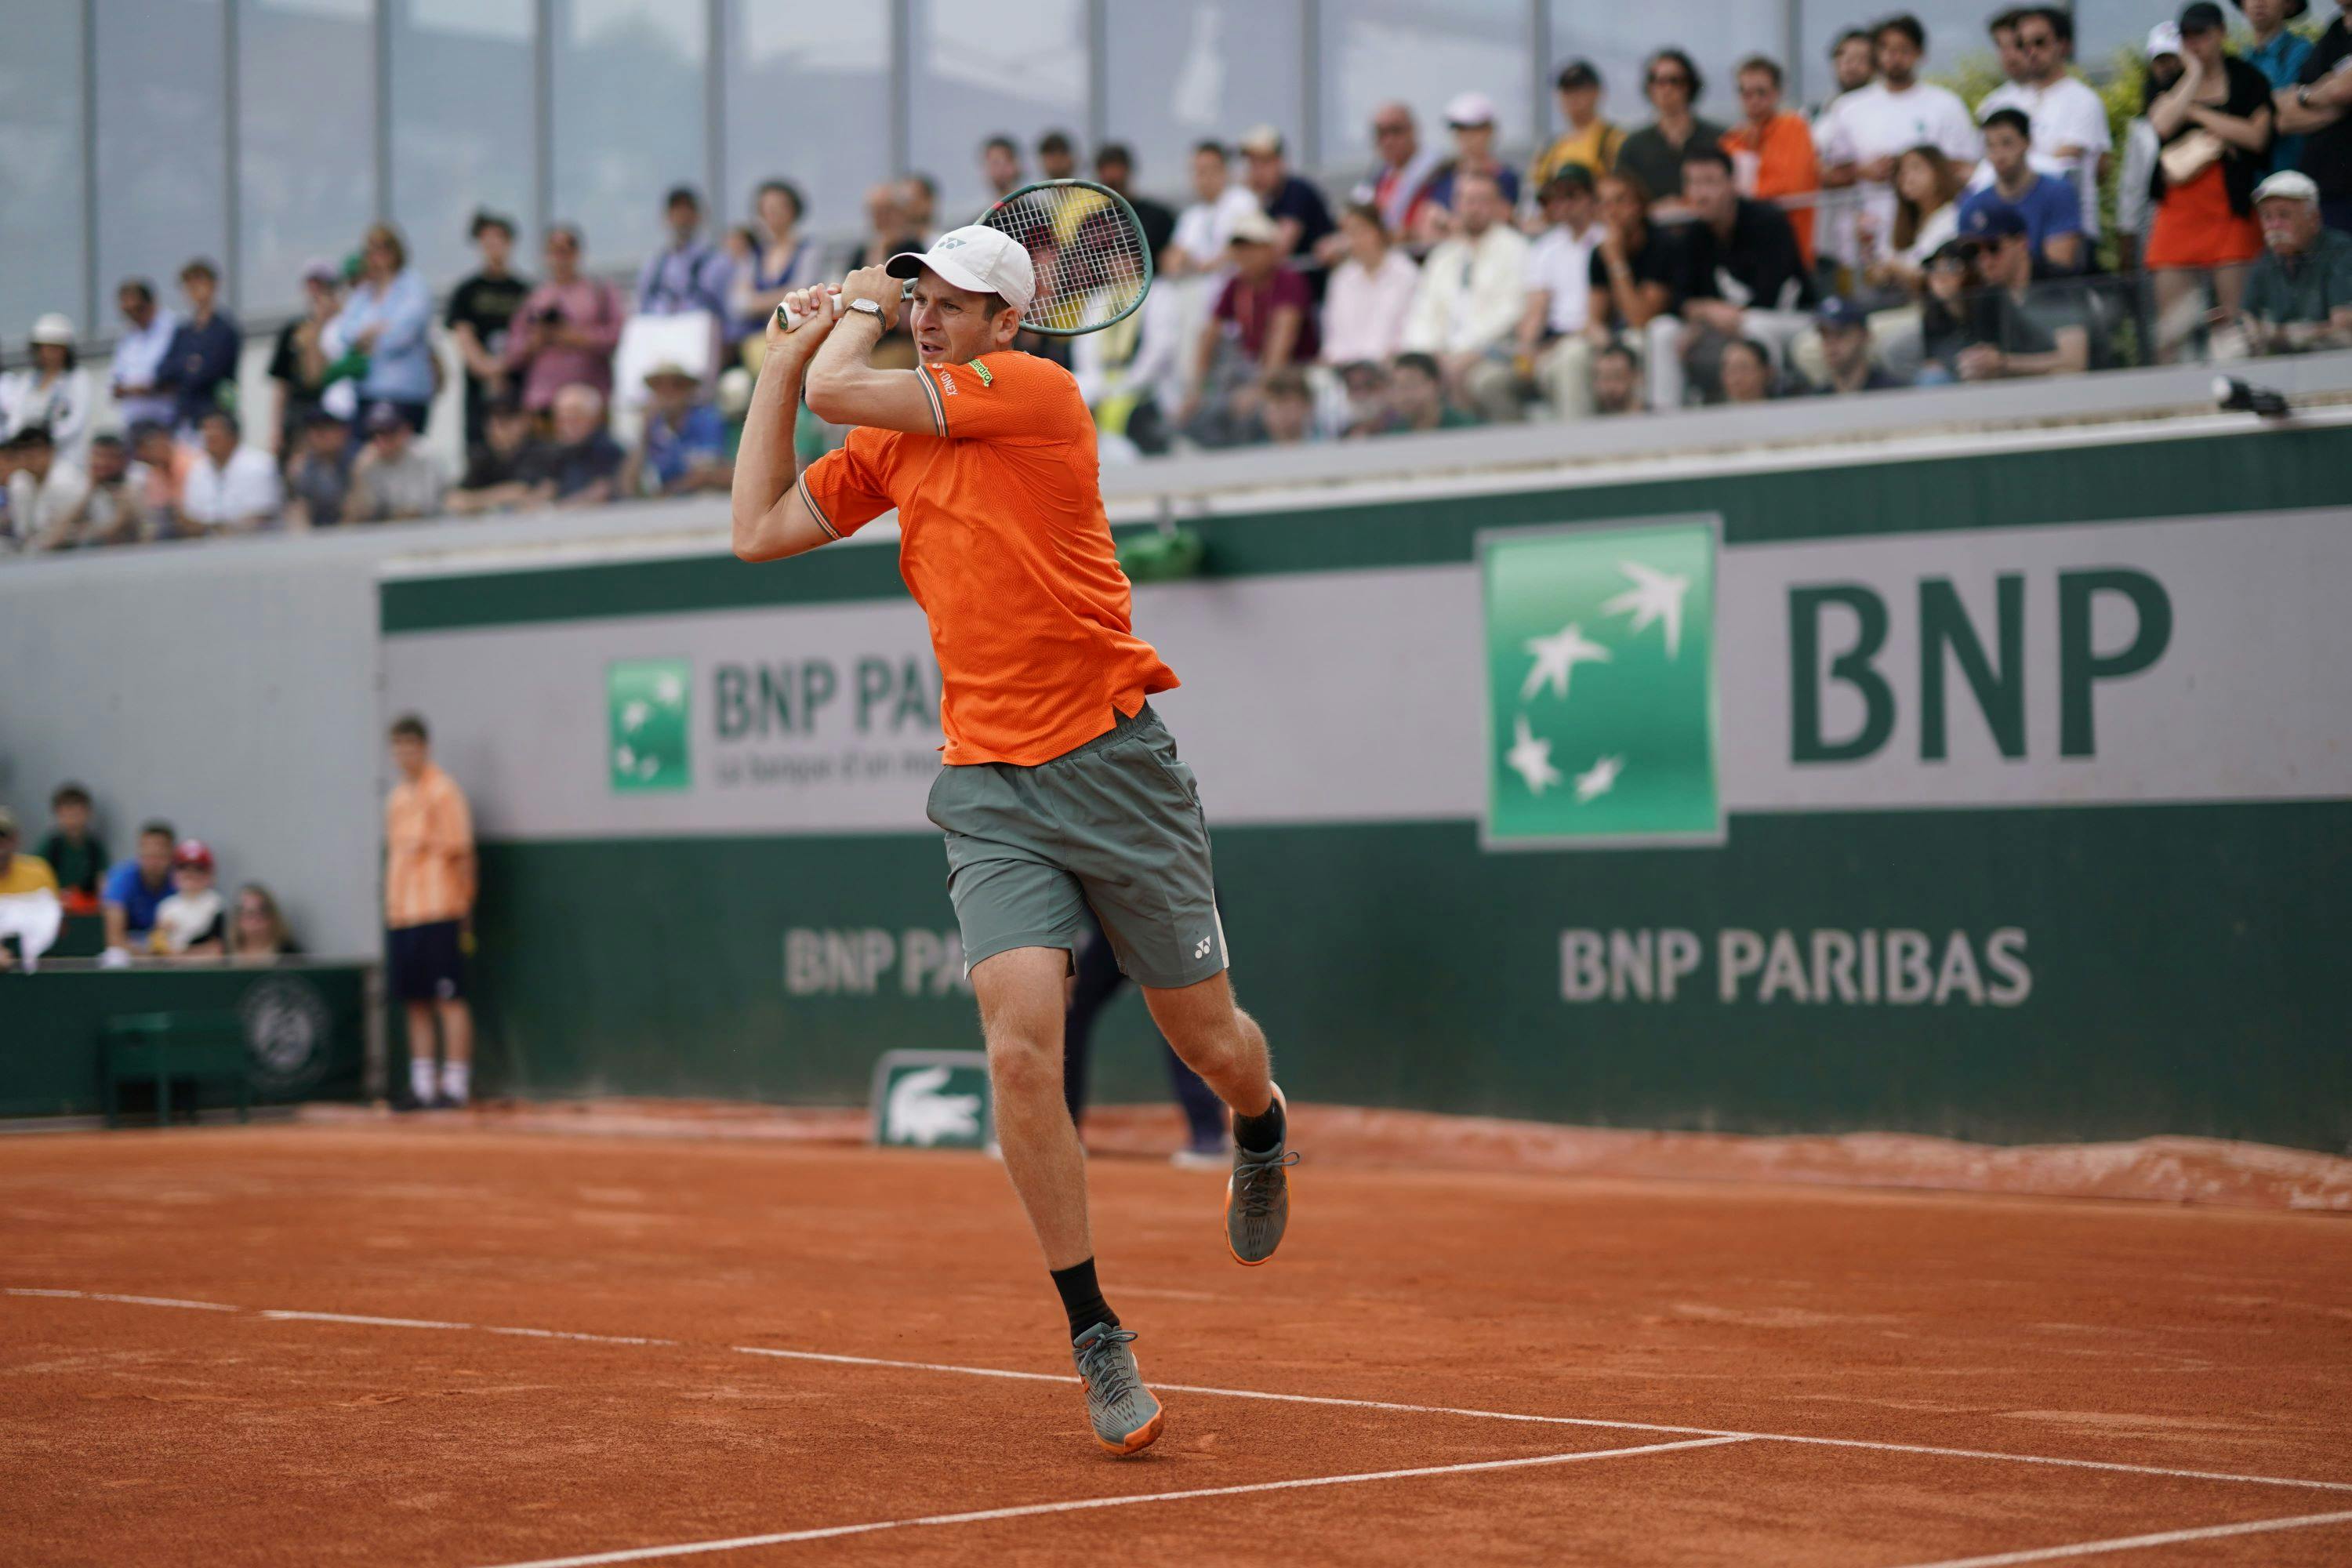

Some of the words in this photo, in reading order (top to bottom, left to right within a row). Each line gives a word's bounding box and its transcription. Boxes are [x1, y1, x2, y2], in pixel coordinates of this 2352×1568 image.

[939, 368, 958, 396] YONEX
[971, 360, 992, 385] terdro
[715, 661, 837, 737] BNP
[856, 657, 944, 734] PA
[1788, 565, 2173, 765] BNP
[786, 928, 895, 994] BNP
[904, 928, 972, 994] PA
[1561, 928, 1702, 1003] BNP
[1719, 927, 2033, 1006] PARIBAS
